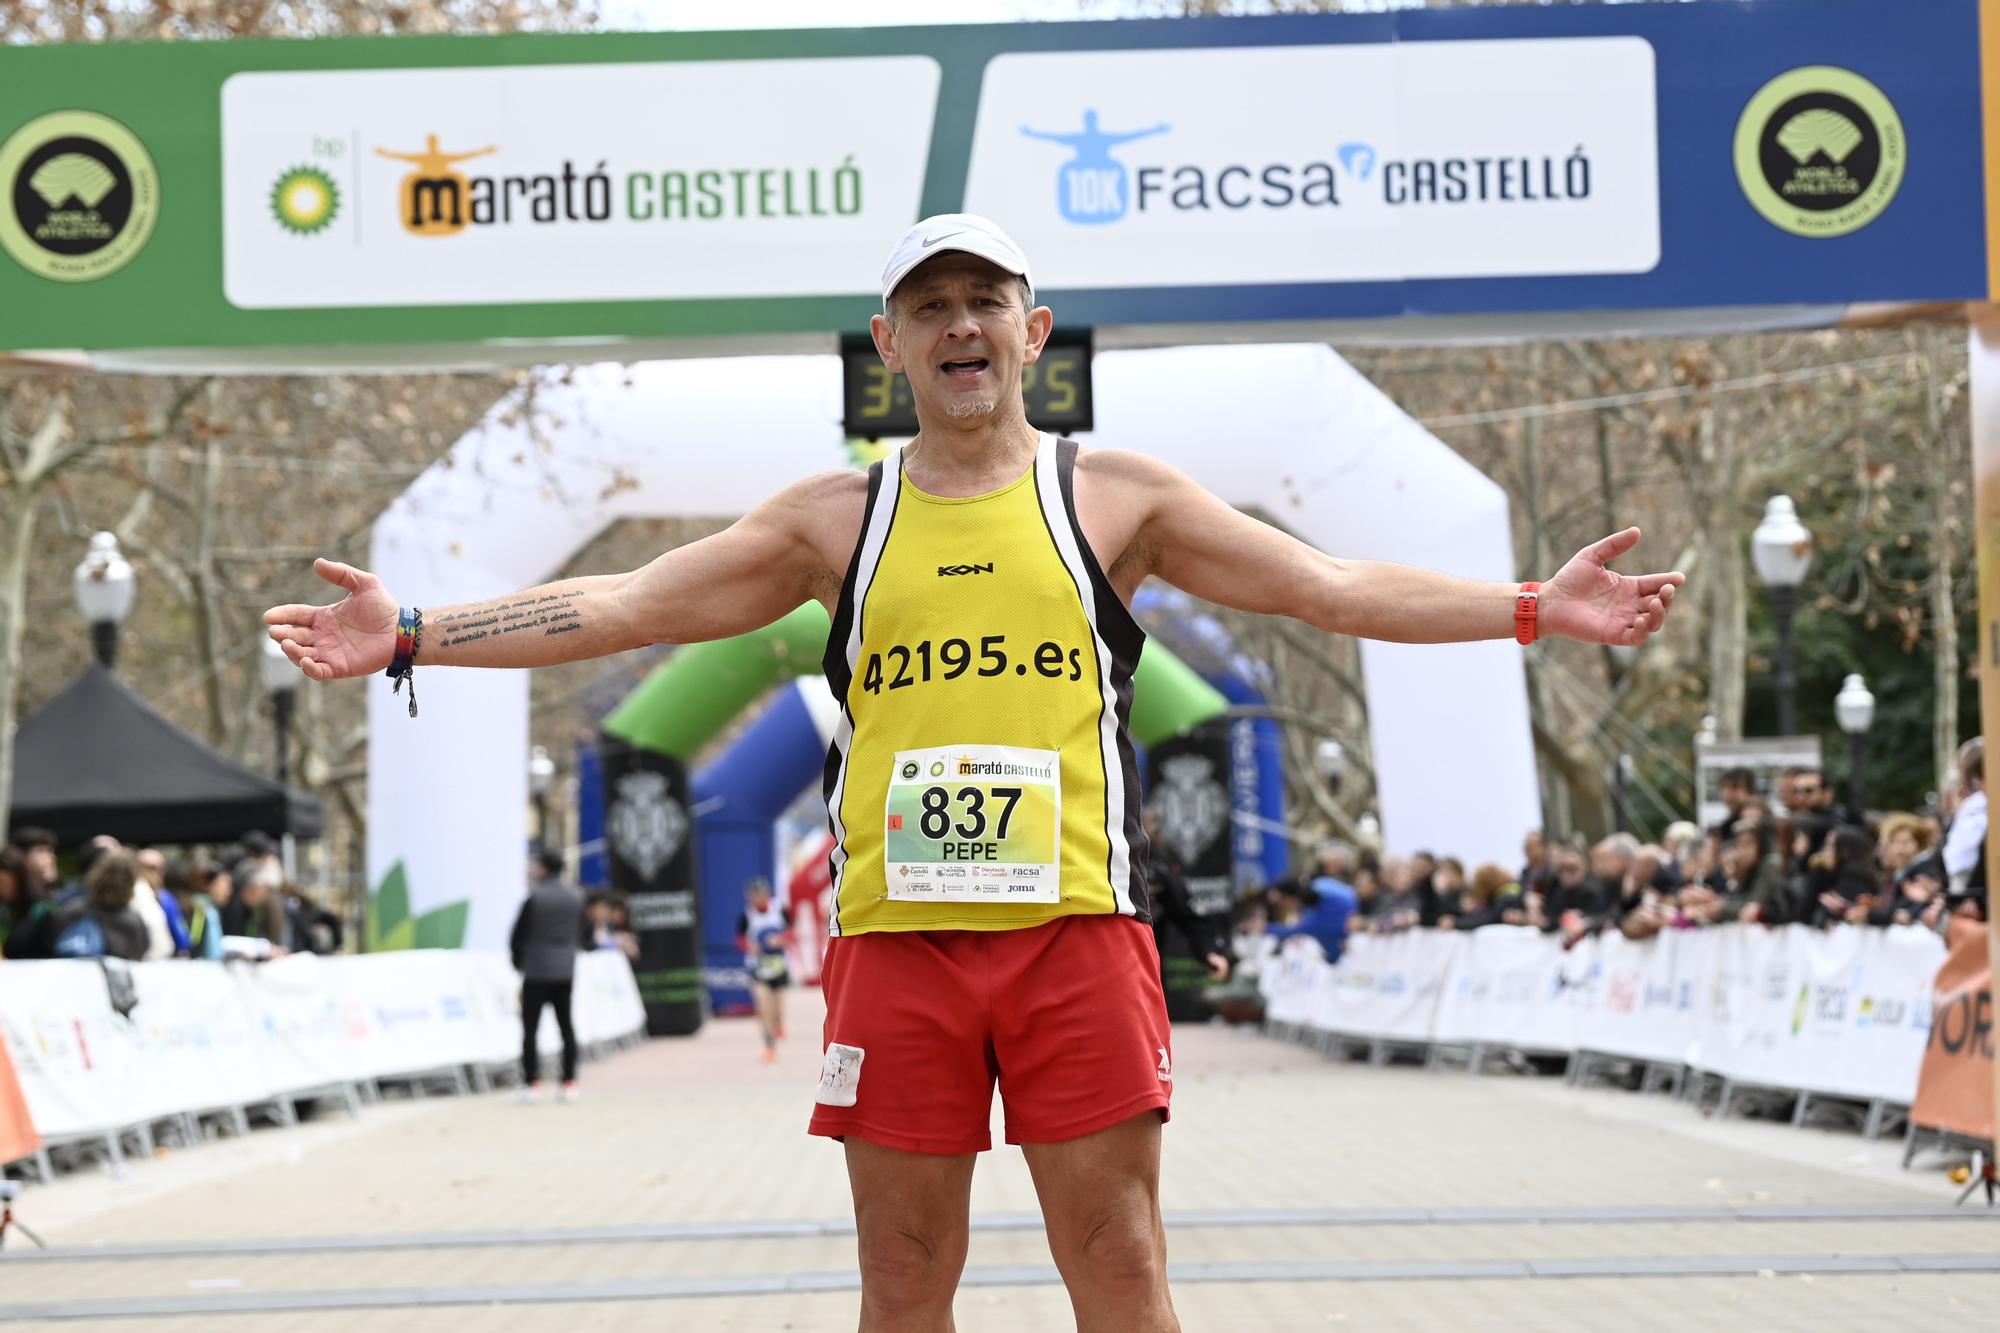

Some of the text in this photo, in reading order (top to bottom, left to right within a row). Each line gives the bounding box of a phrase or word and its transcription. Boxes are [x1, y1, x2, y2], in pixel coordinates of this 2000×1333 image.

[314, 138, 344, 157] bp
[411, 154, 861, 227] marató CASTELLÓ
[1067, 169, 1122, 214] 10K
[1384, 144, 1590, 204] CASTELLÓ
[863, 635, 1081, 695] 42195.es
[959, 761, 1052, 779] marató CASTELLÓ
[920, 786, 1023, 840] 837
[943, 842, 998, 860] PEPE
